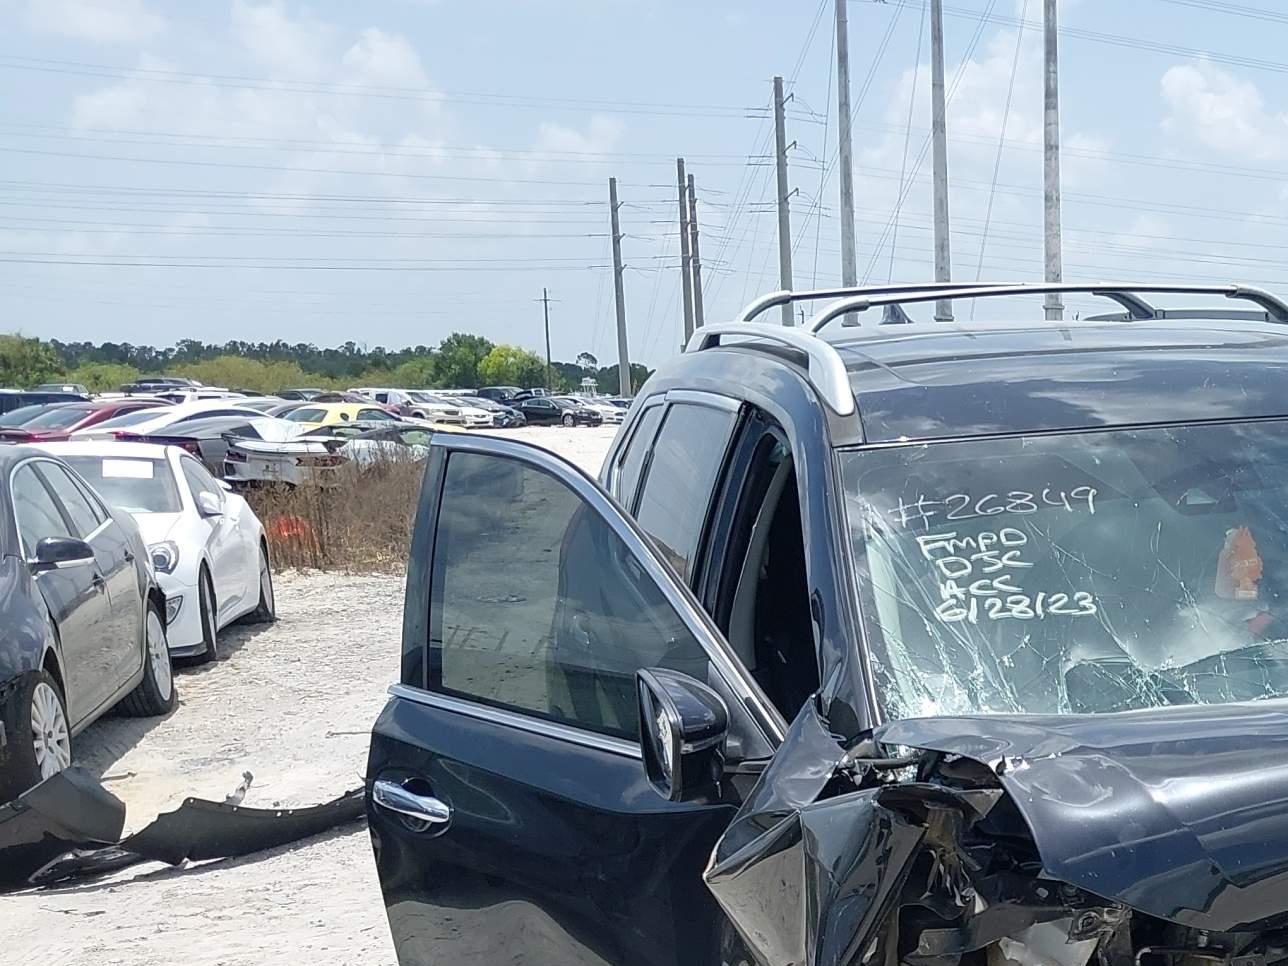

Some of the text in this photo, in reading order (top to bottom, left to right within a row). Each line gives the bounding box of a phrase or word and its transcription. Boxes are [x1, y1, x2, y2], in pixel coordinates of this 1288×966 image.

[888, 486, 1097, 530] #26849
[940, 575, 1023, 600] ACC
[934, 592, 1097, 624] 6/28/23
